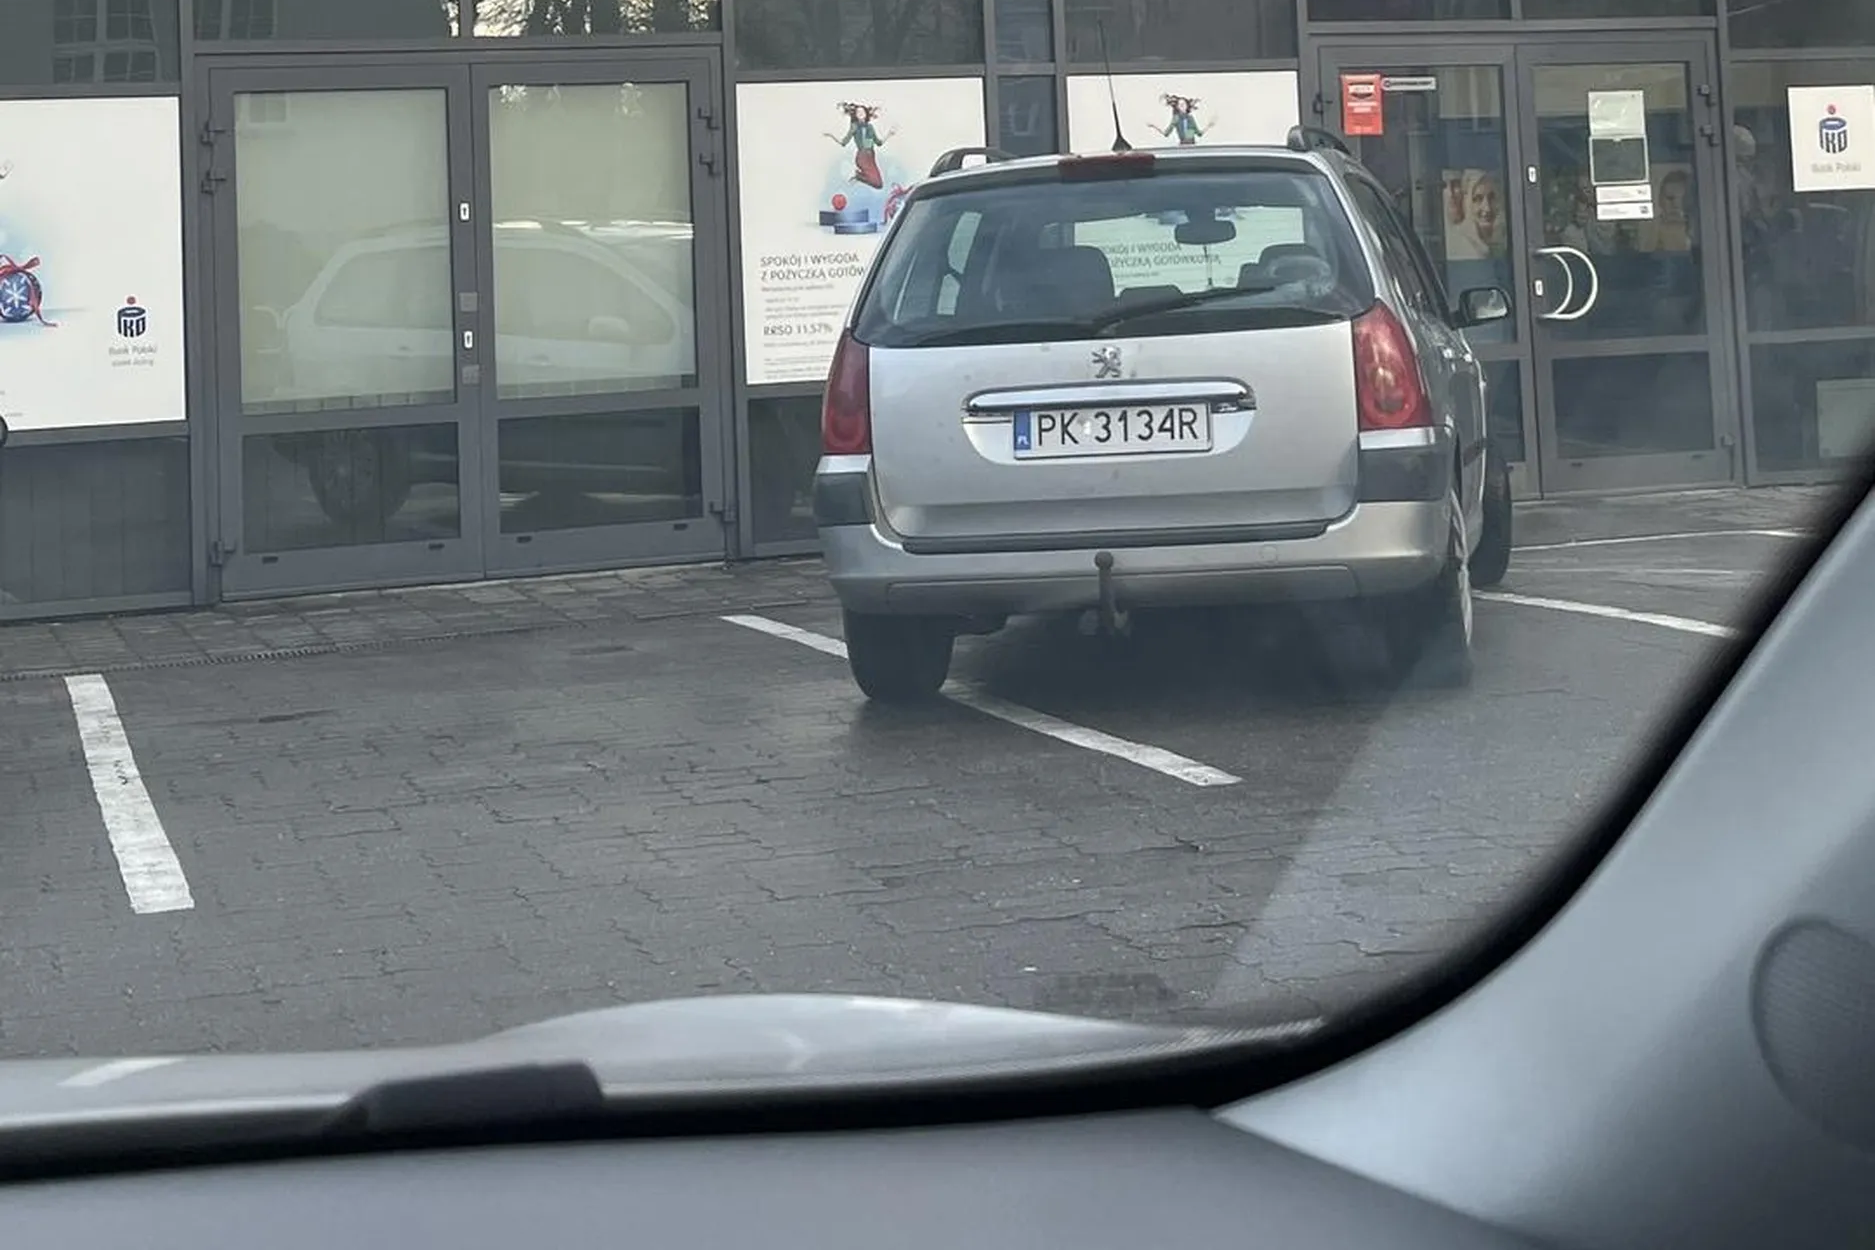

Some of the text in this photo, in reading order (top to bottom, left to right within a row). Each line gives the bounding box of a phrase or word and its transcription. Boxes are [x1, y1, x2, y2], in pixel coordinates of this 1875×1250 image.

[760, 254, 801, 268] SPOKÓJ
[810, 253, 860, 265] WYGODA
[1038, 407, 1199, 446] PK 3134R
